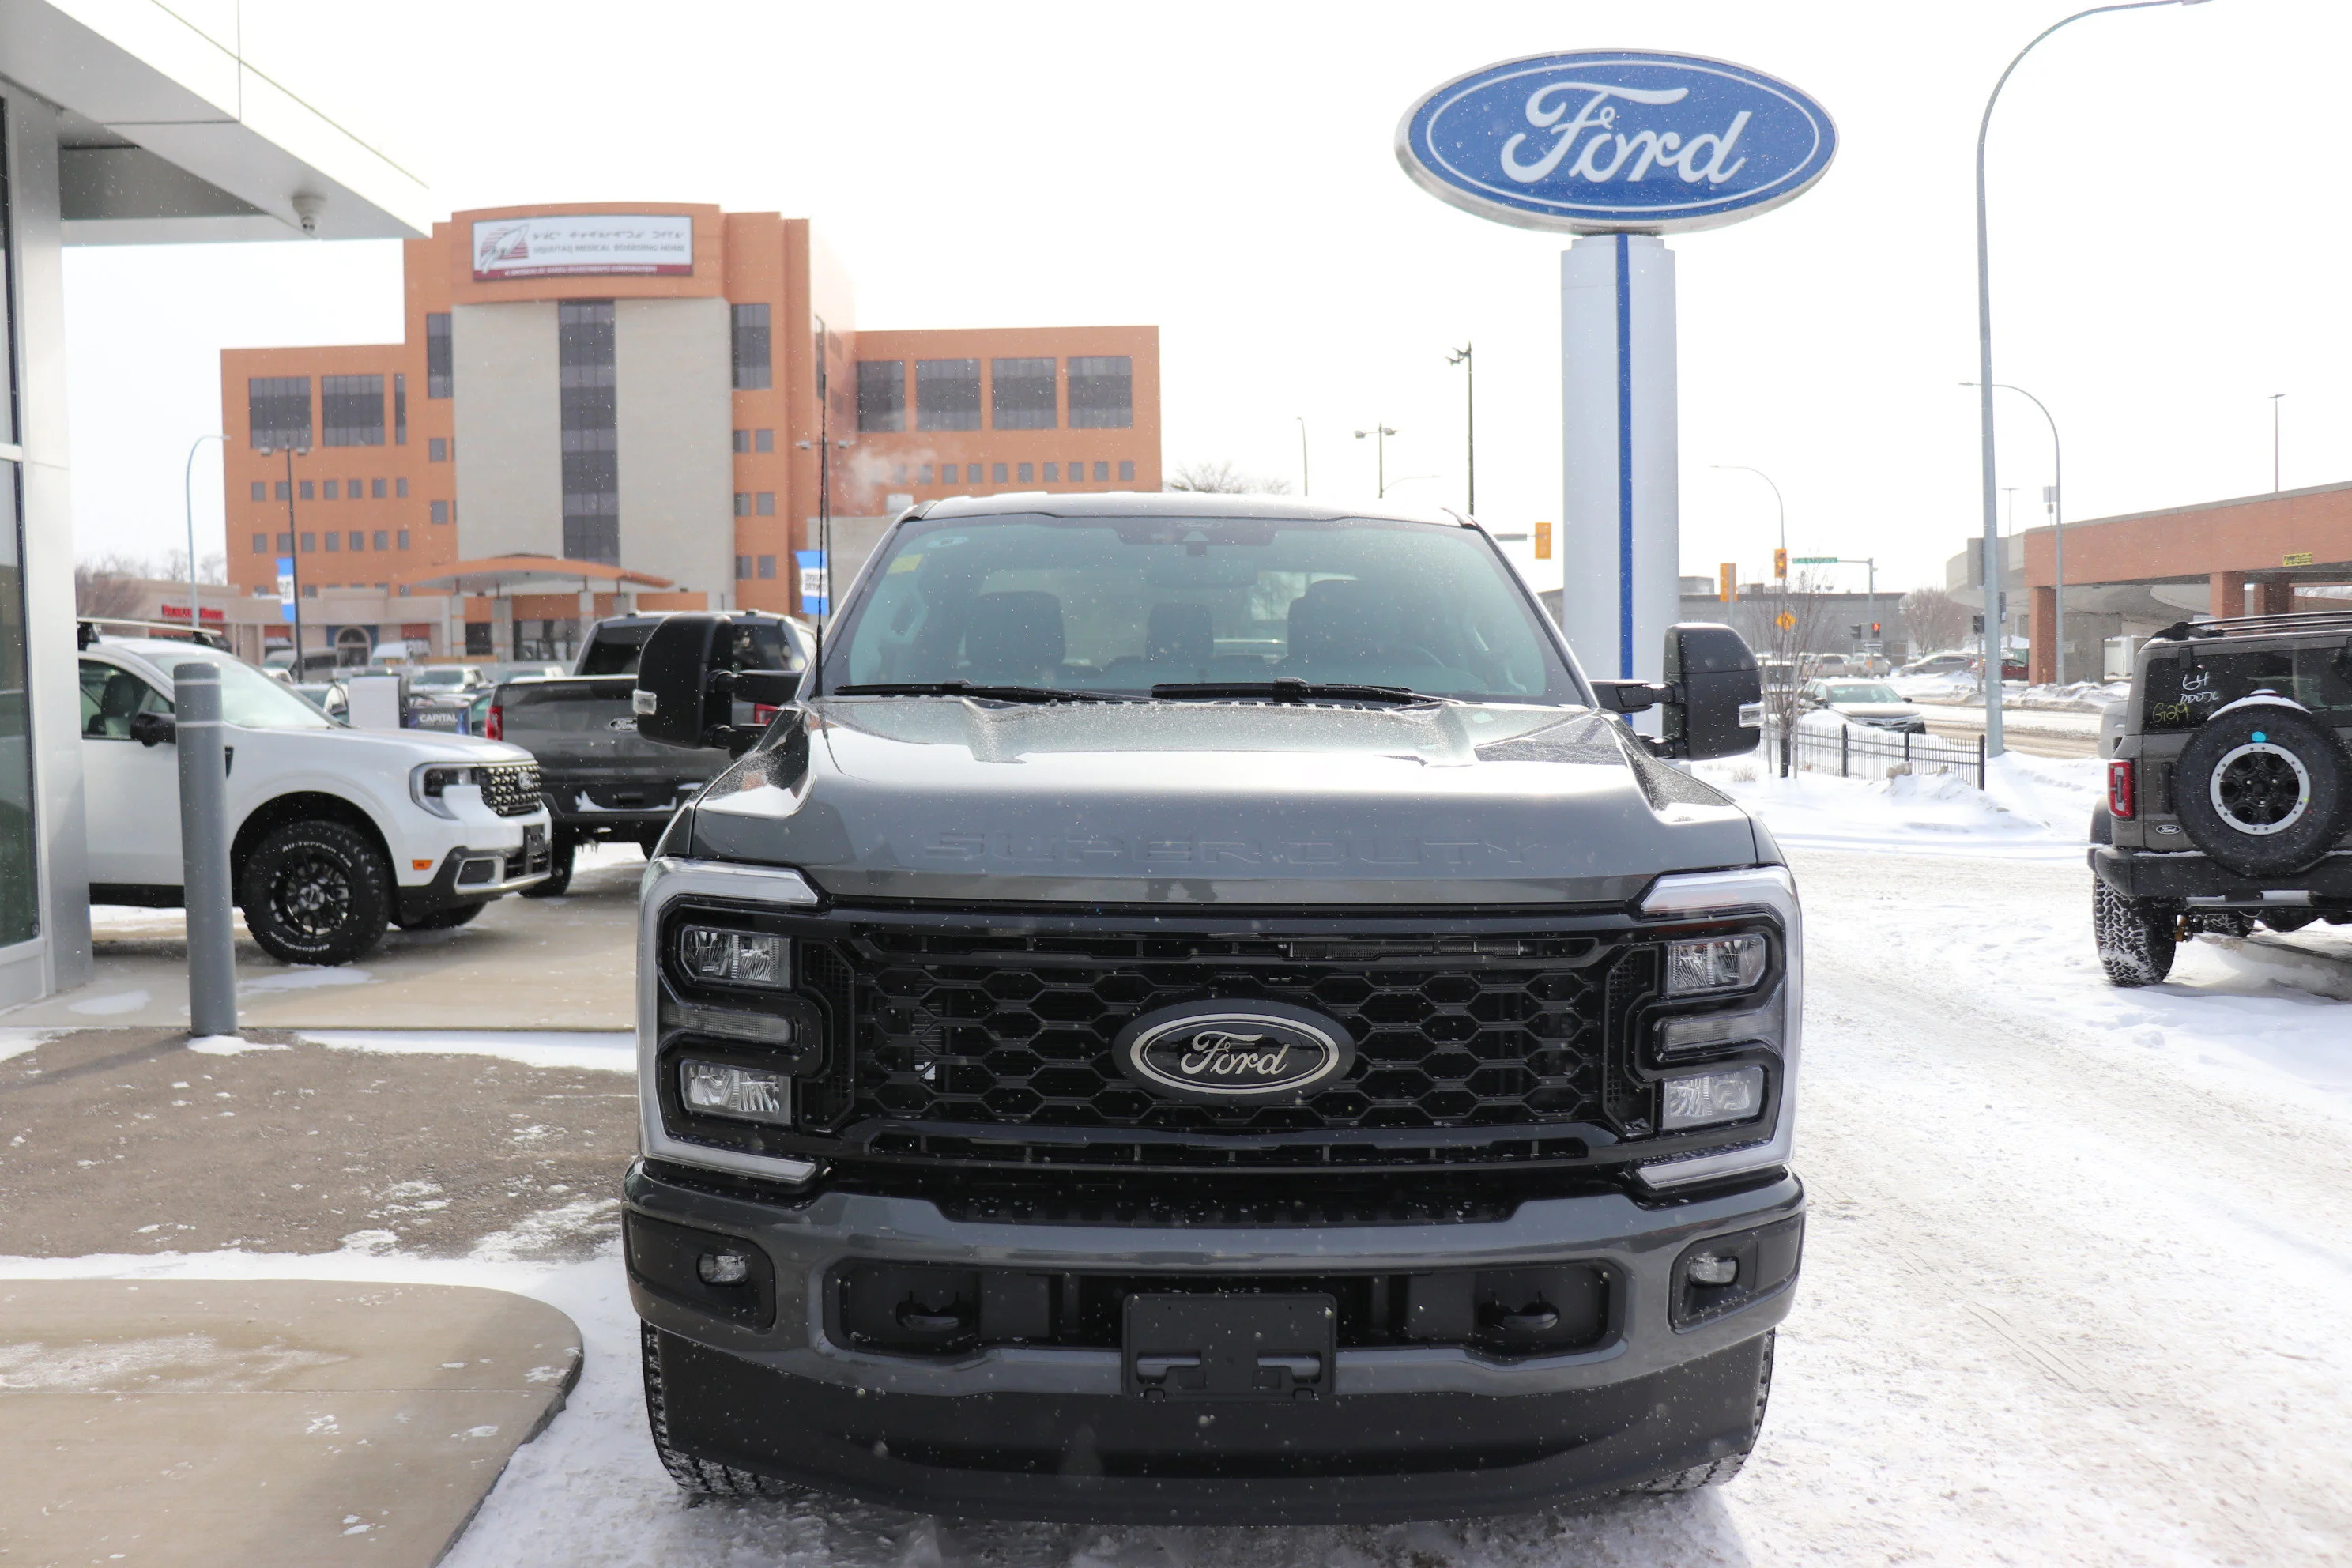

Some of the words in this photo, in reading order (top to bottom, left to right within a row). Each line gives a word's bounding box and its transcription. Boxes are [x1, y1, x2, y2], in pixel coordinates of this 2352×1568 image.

[1501, 81, 1752, 184] Ford
[420, 713, 458, 722] CAPITAL
[924, 832, 1261, 864] SUPER
[1287, 838, 1540, 865] DUTY
[1180, 1030, 1291, 1075] Ford
